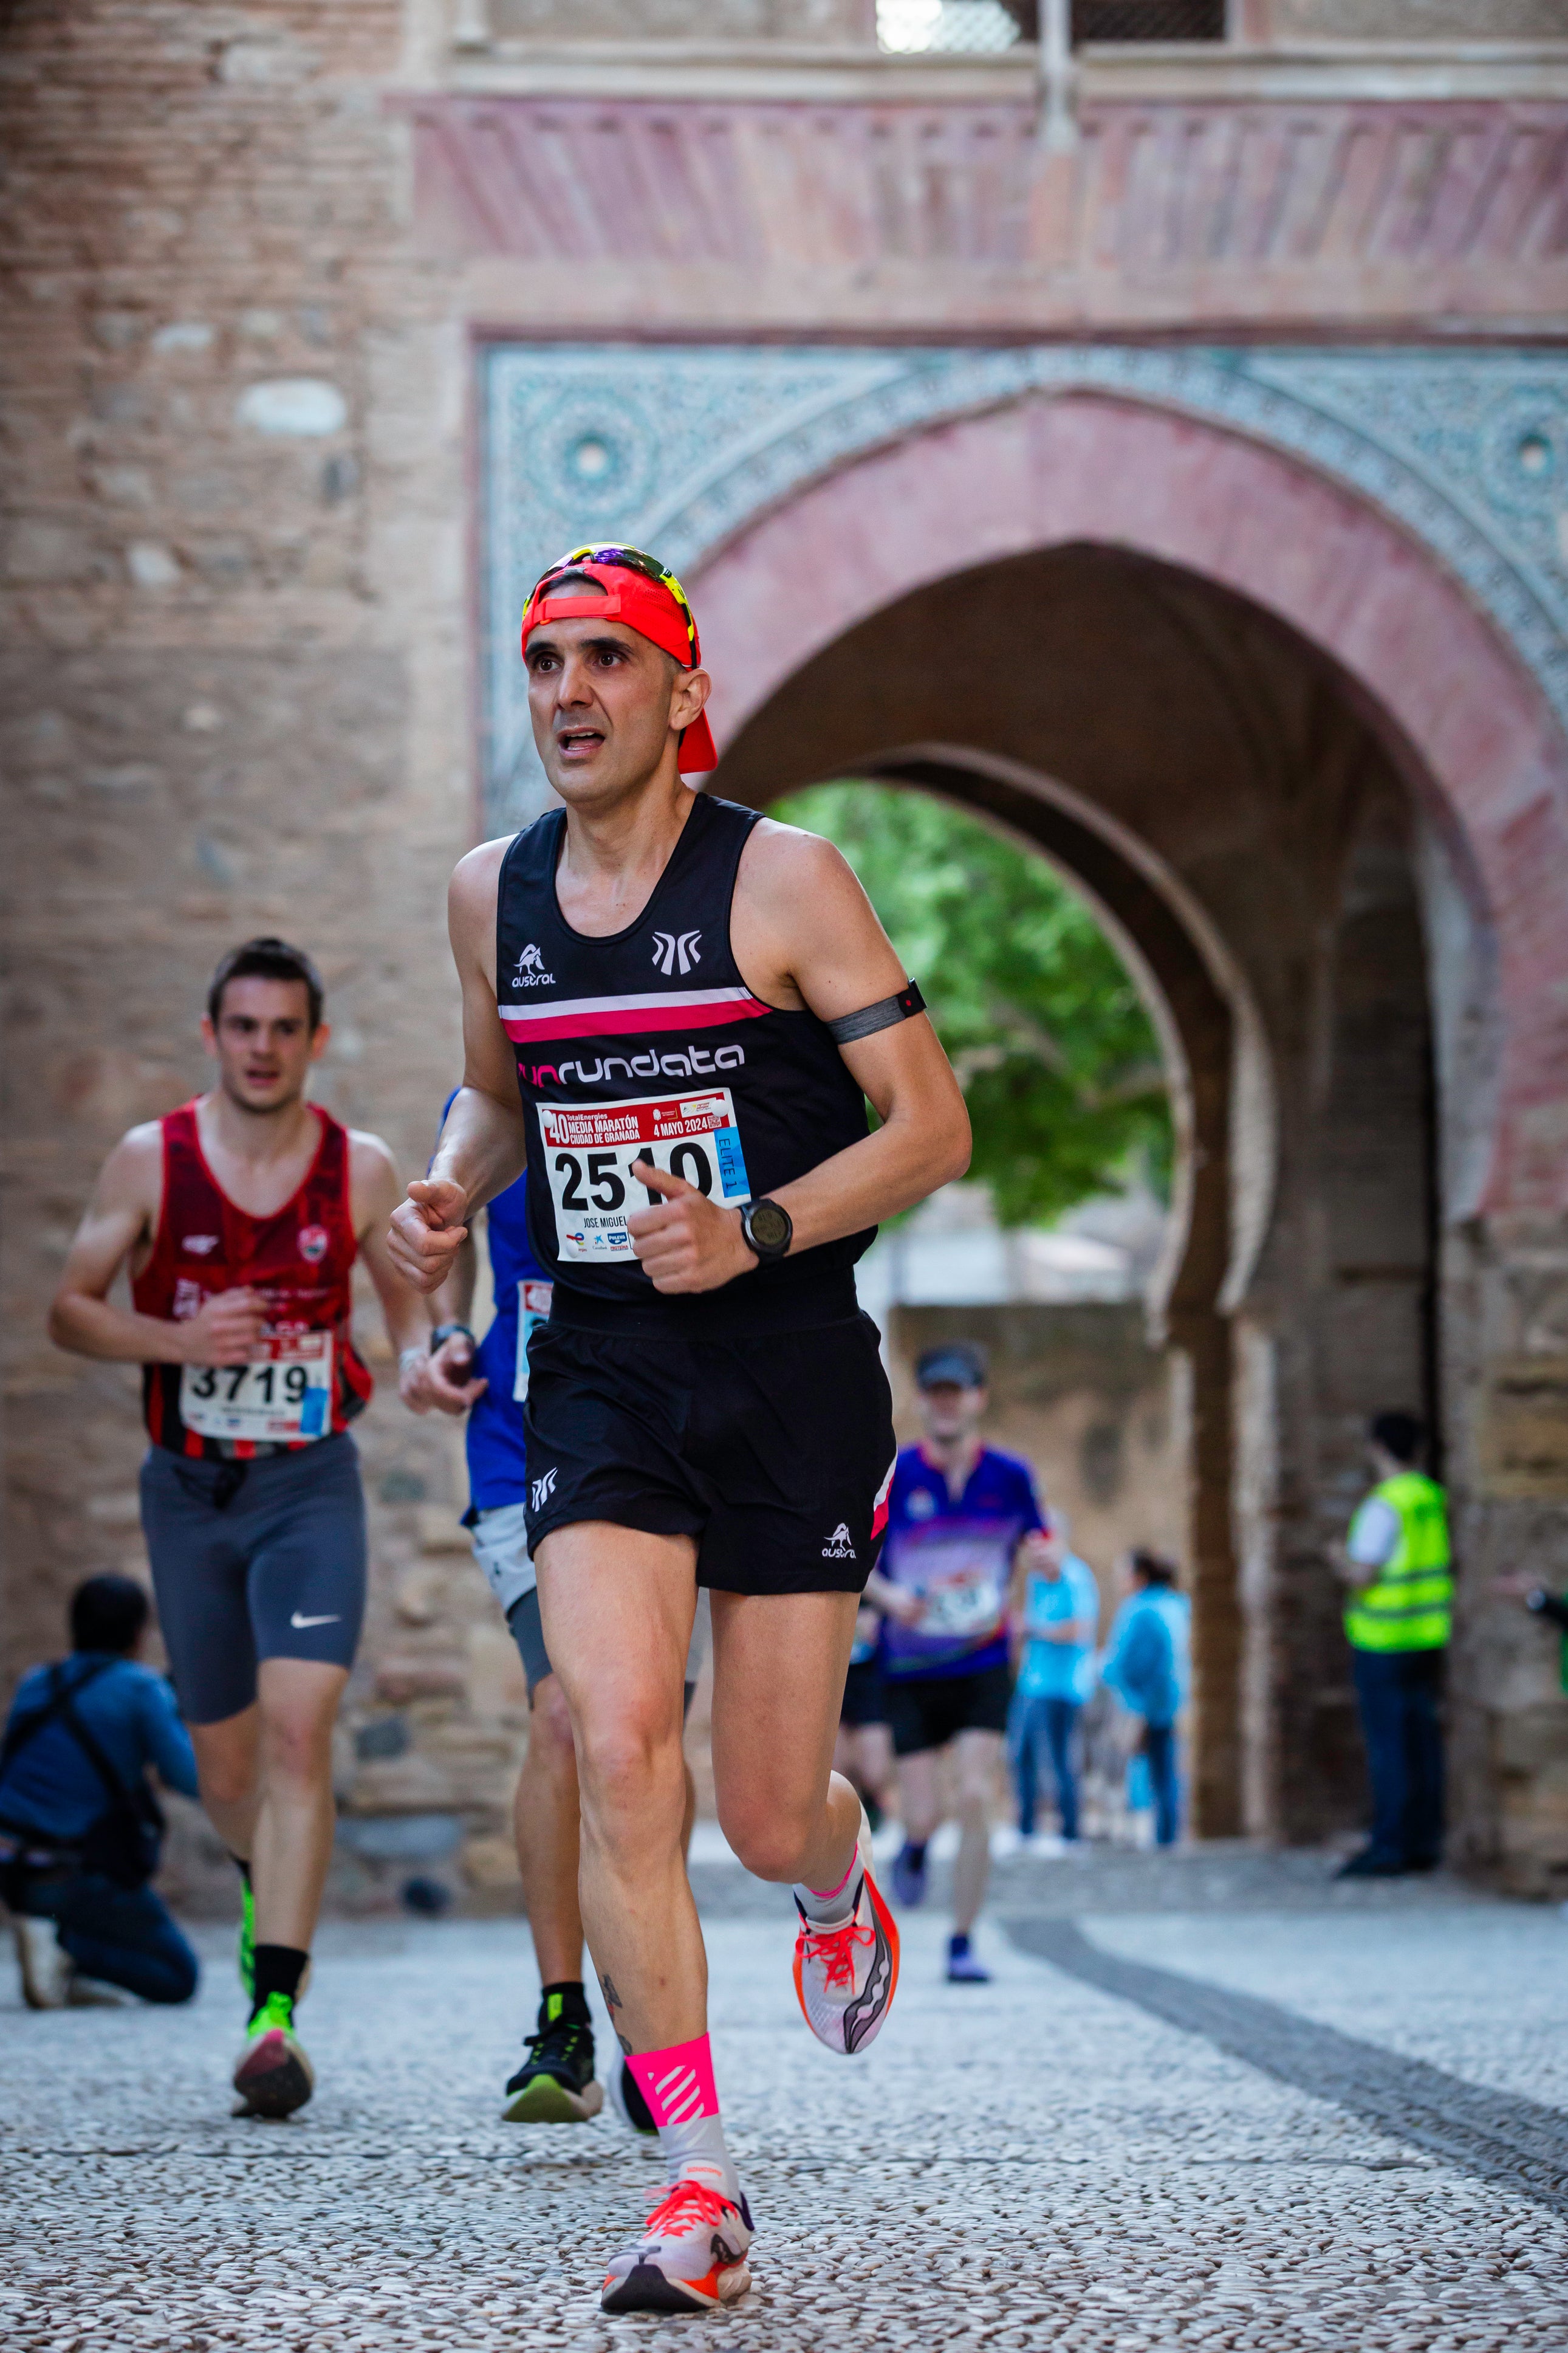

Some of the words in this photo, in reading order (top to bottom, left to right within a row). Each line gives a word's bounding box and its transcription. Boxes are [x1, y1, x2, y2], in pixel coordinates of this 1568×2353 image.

[512, 974, 556, 988] austral
[566, 1113, 608, 1122] TotalEnergies
[567, 1121, 594, 1134] MEDIA
[594, 1115, 638, 1133] MARATÓN
[654, 1124, 660, 1137] 4
[660, 1121, 684, 1136] MAYO
[685, 1117, 708, 1133] 2024
[550, 1113, 569, 1144] 40
[570, 1134, 593, 1144] CIUDAD
[594, 1133, 603, 1144] DE
[604, 1129, 640, 1144] GRANADA
[719, 1138, 735, 1176] ELITE
[555, 1142, 712, 1211] 2510
[584, 1218, 599, 1228] JOSE
[600, 1216, 627, 1228] MIGUEL
[192, 1365, 308, 1406] 3719
[822, 1548, 856, 1559] austra
